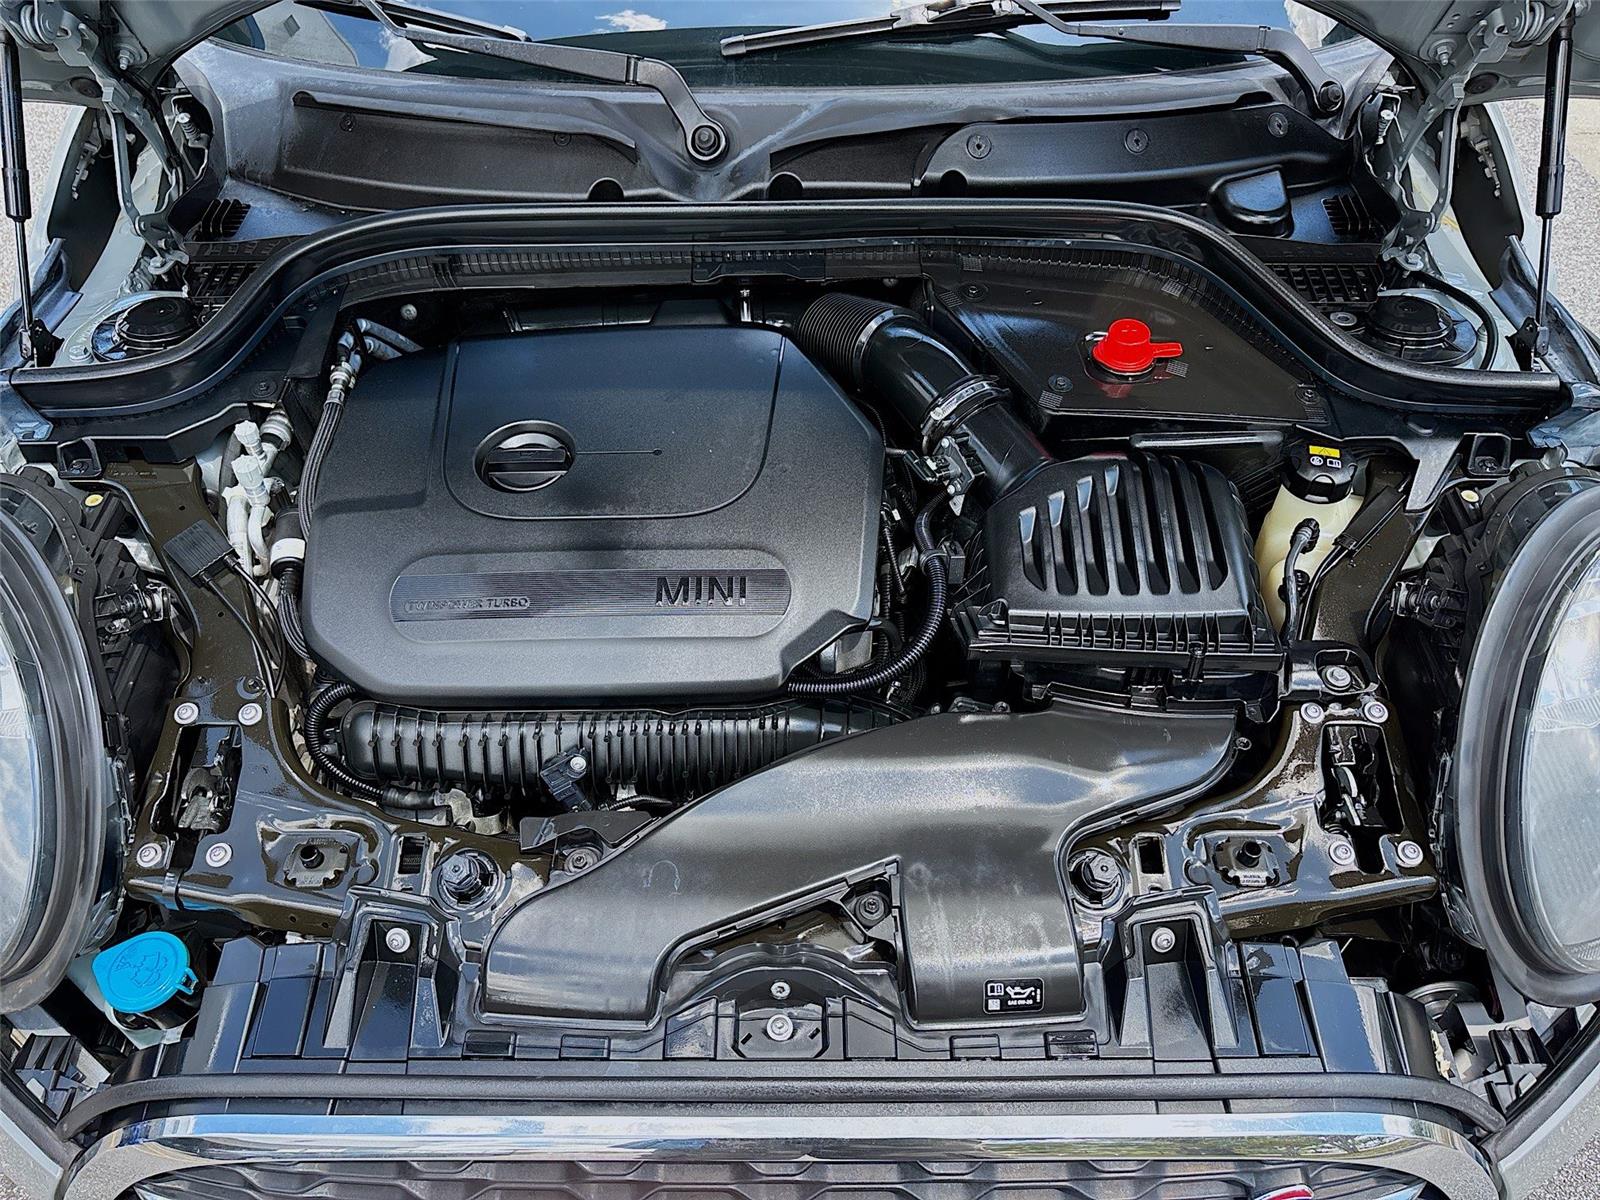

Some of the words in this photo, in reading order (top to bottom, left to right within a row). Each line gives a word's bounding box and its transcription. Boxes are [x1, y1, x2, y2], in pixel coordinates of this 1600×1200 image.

[655, 575, 746, 606] MINI
[407, 599, 483, 611] TWINPOWER
[487, 597, 528, 608] TURBO
